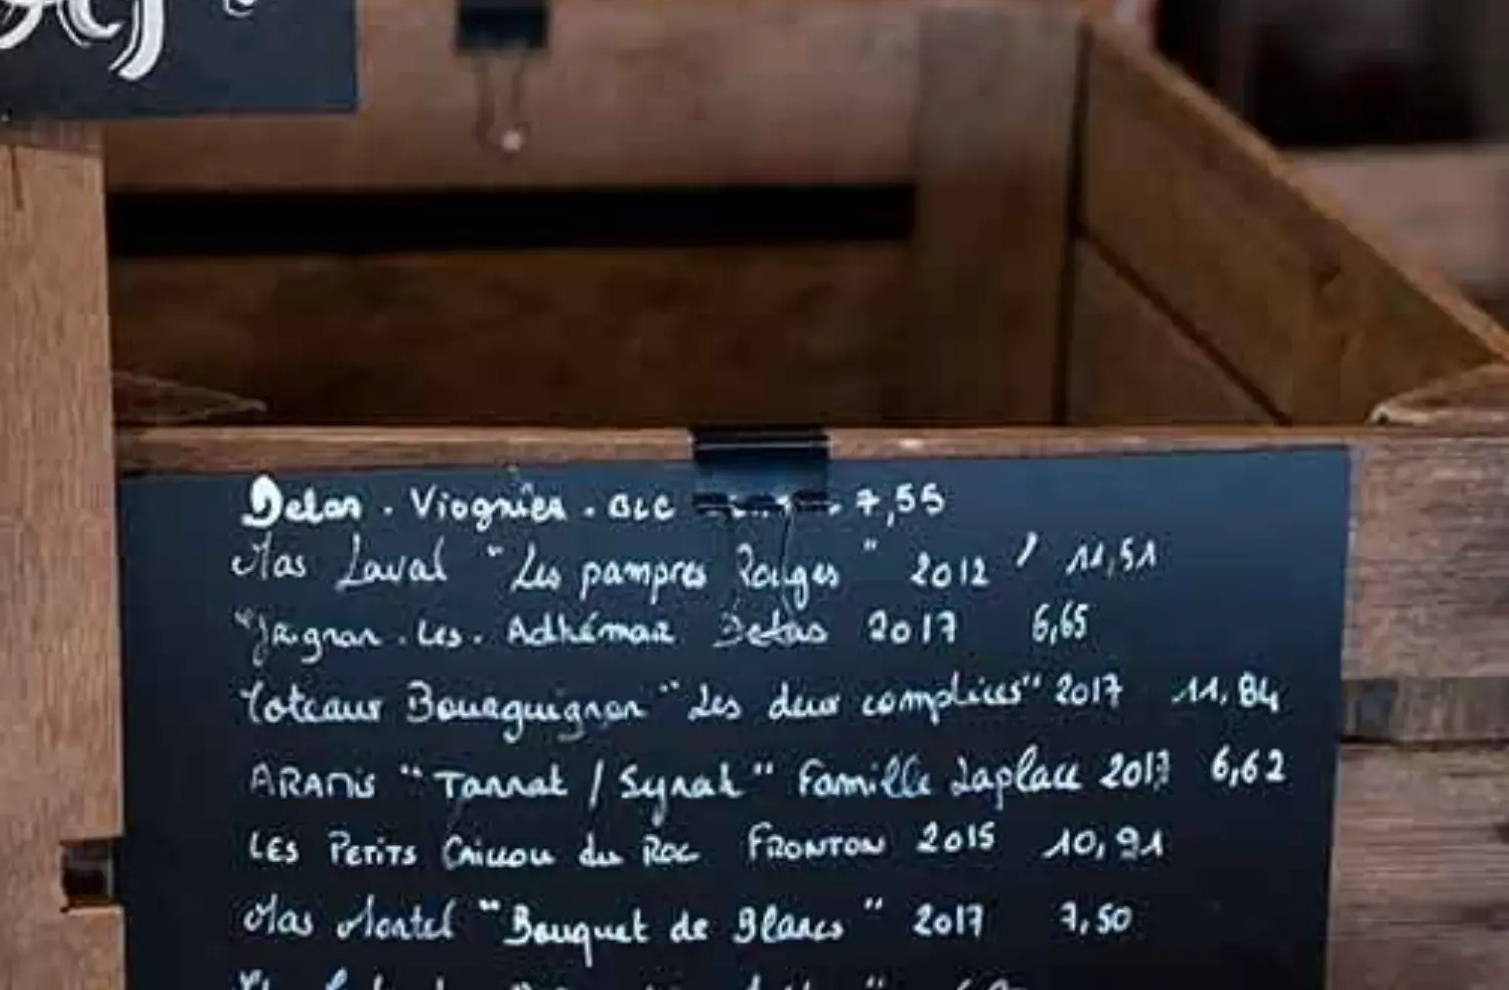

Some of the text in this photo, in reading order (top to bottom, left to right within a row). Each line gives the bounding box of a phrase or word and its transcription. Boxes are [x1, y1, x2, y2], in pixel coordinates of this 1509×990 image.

[855, 482, 945, 527] 7,55
[336, 533, 448, 590] Laval
[579, 560, 707, 606] pampres
[910, 551, 989, 589] 2012
[868, 609, 956, 644] 2017
[1032, 600, 1089, 645] 6,65
[768, 681, 841, 720] deux
[1055, 672, 1123, 707] 2017
[1172, 671, 1279, 713] 11,84
[798, 754, 931, 799] Famille
[1211, 745, 1285, 787] 6,62
[578, 832, 624, 868] du
[916, 821, 995, 853] 2015
[1043, 826, 1164, 859] 10,91
[669, 911, 709, 944] de
[913, 903, 983, 938] 2017
[1061, 901, 1132, 935] 7,50
